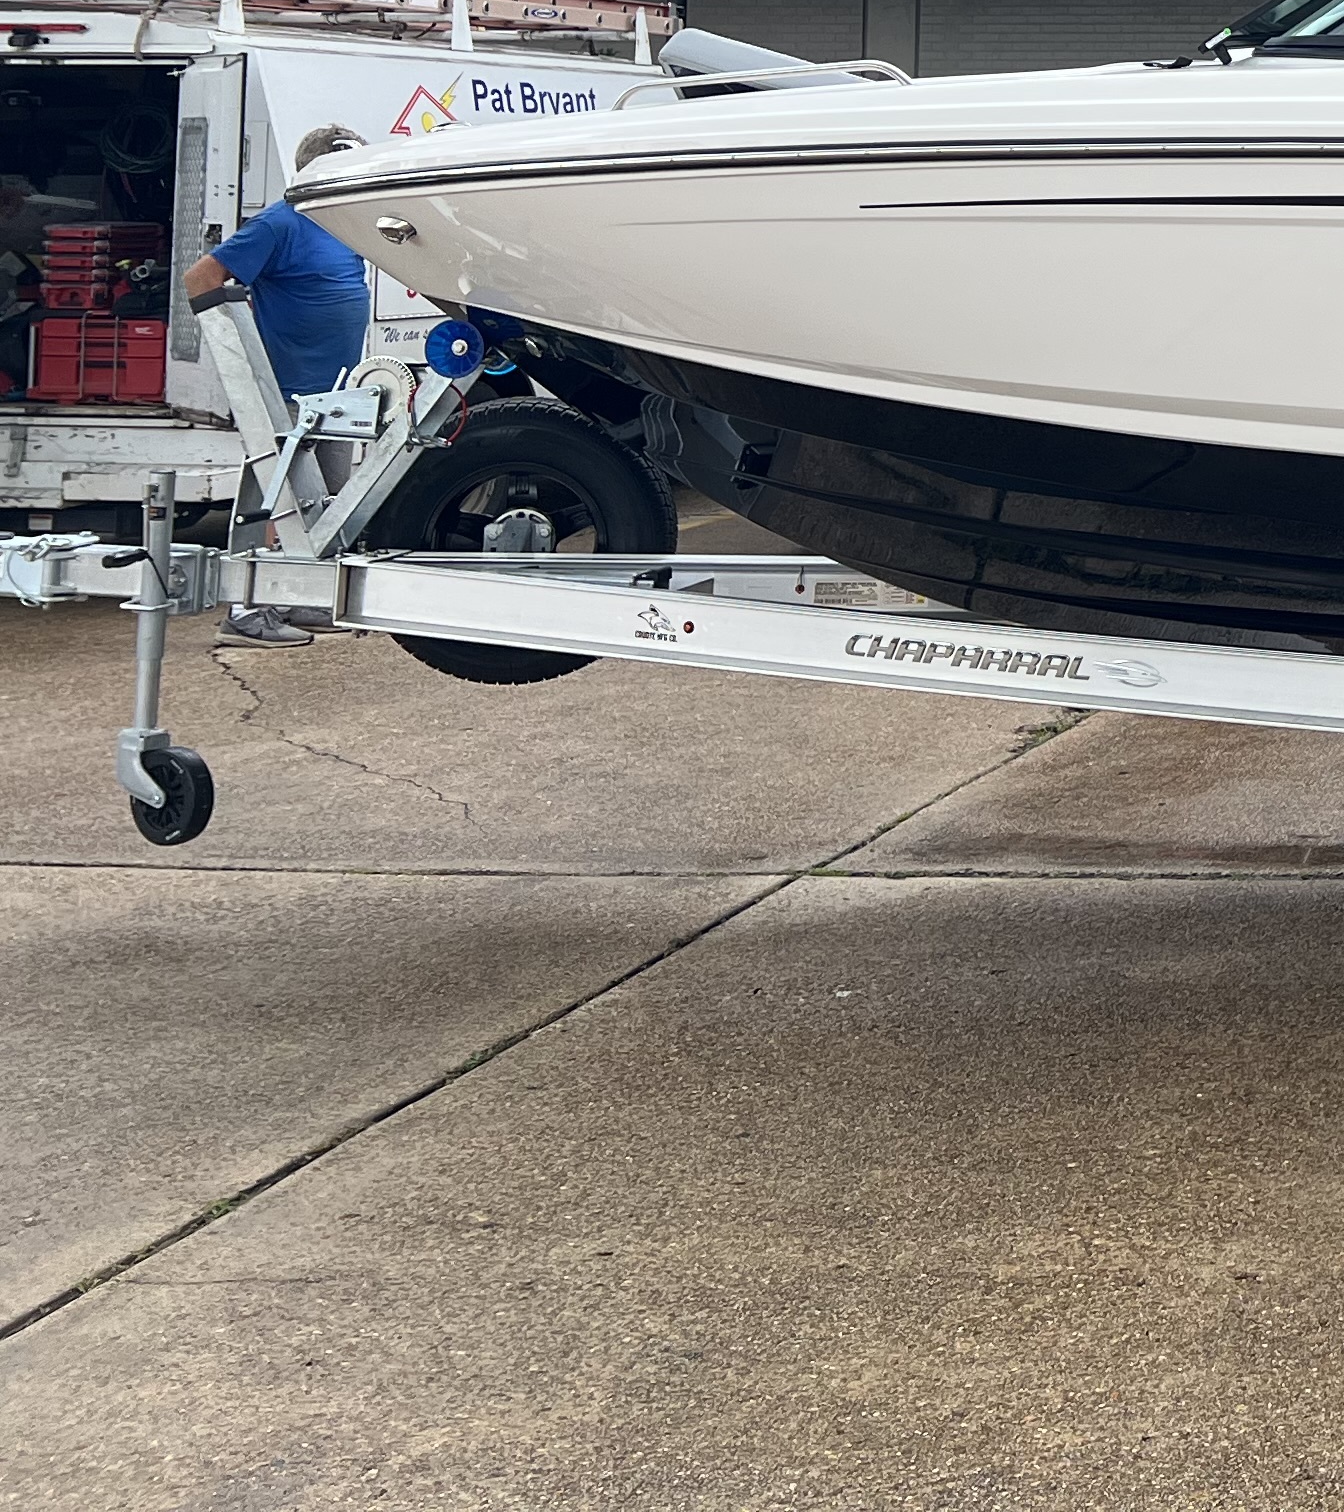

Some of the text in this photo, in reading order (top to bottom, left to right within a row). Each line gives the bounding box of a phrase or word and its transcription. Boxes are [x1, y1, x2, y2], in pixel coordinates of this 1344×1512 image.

[471, 79, 596, 115] Pat Bryant
[845, 634, 1090, 681] CHAPARRAL
